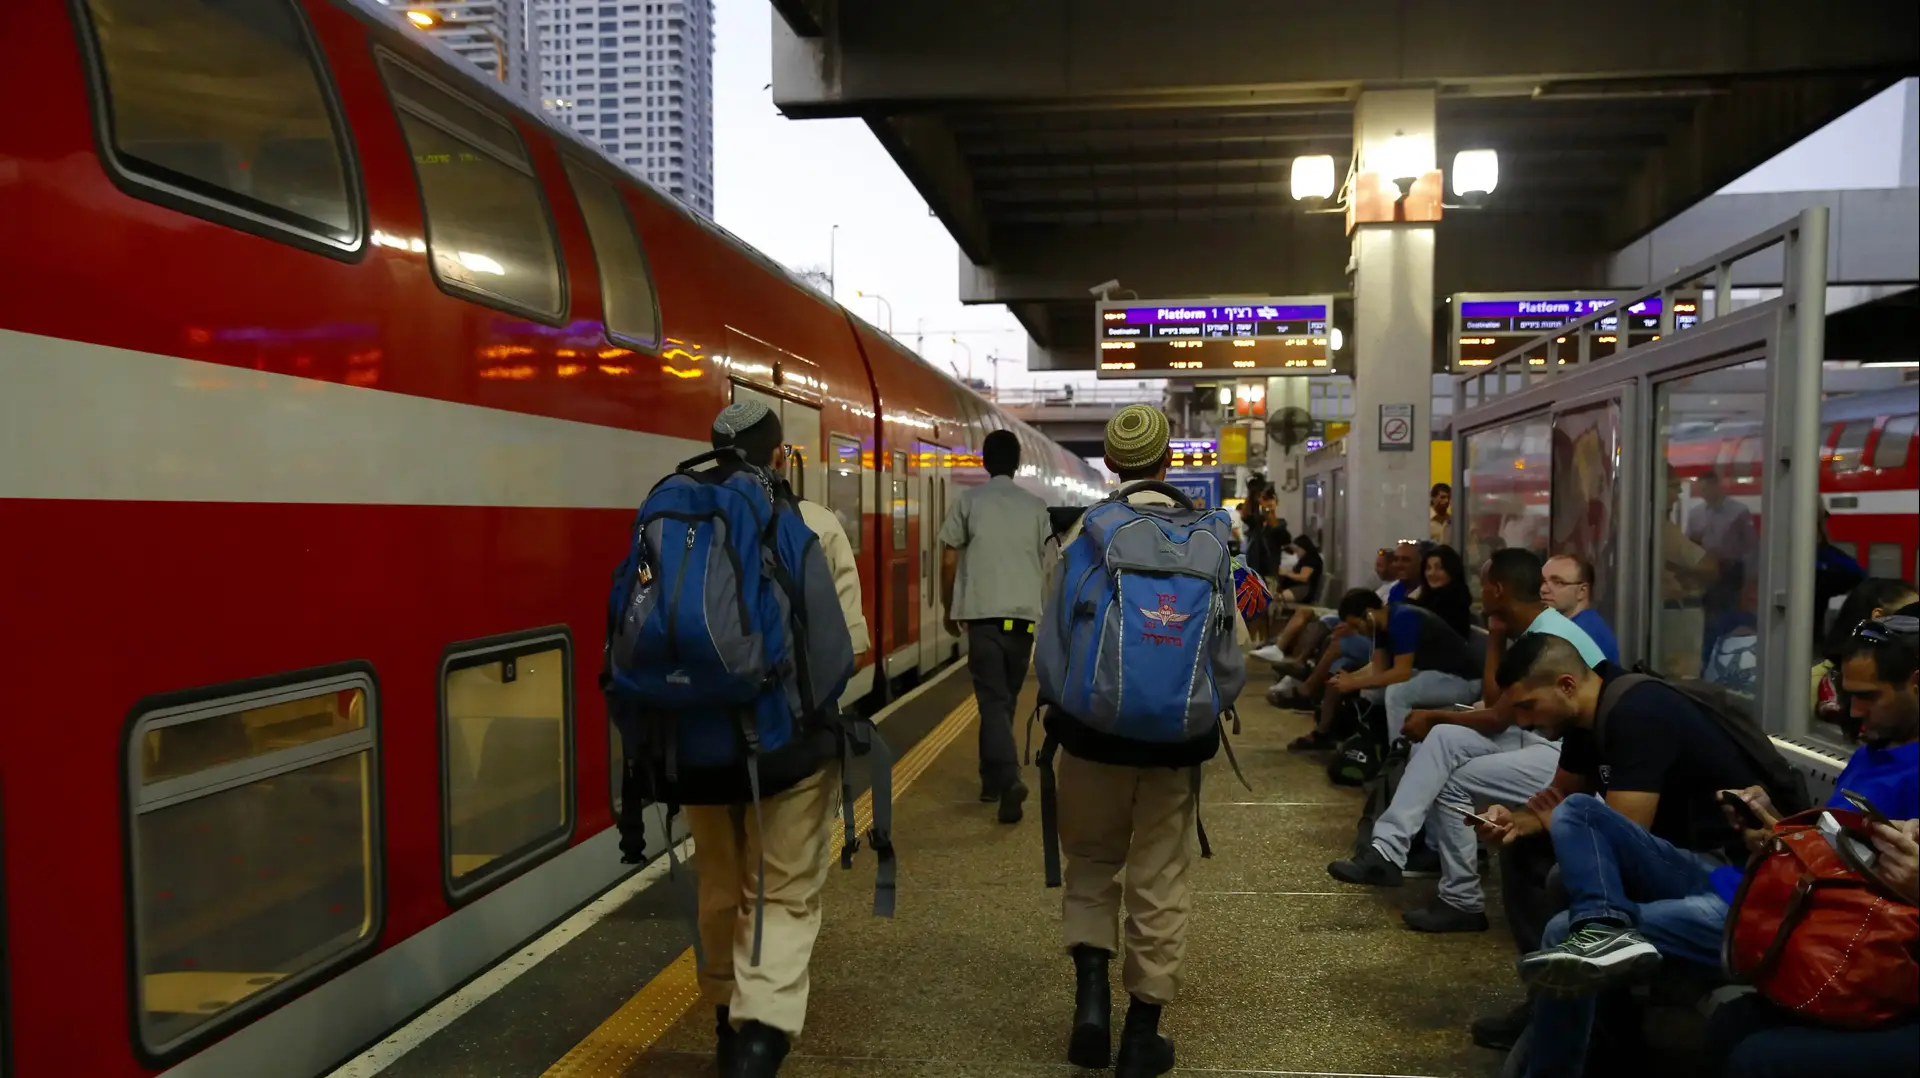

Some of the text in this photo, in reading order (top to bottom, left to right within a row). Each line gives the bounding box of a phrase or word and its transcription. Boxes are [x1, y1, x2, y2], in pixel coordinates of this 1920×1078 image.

[1518, 302, 1569, 313] Platform
[1574, 302, 1583, 312] 2
[1157, 307, 1252, 321] Platform 1 רציף
[1108, 328, 1140, 336] Destination
